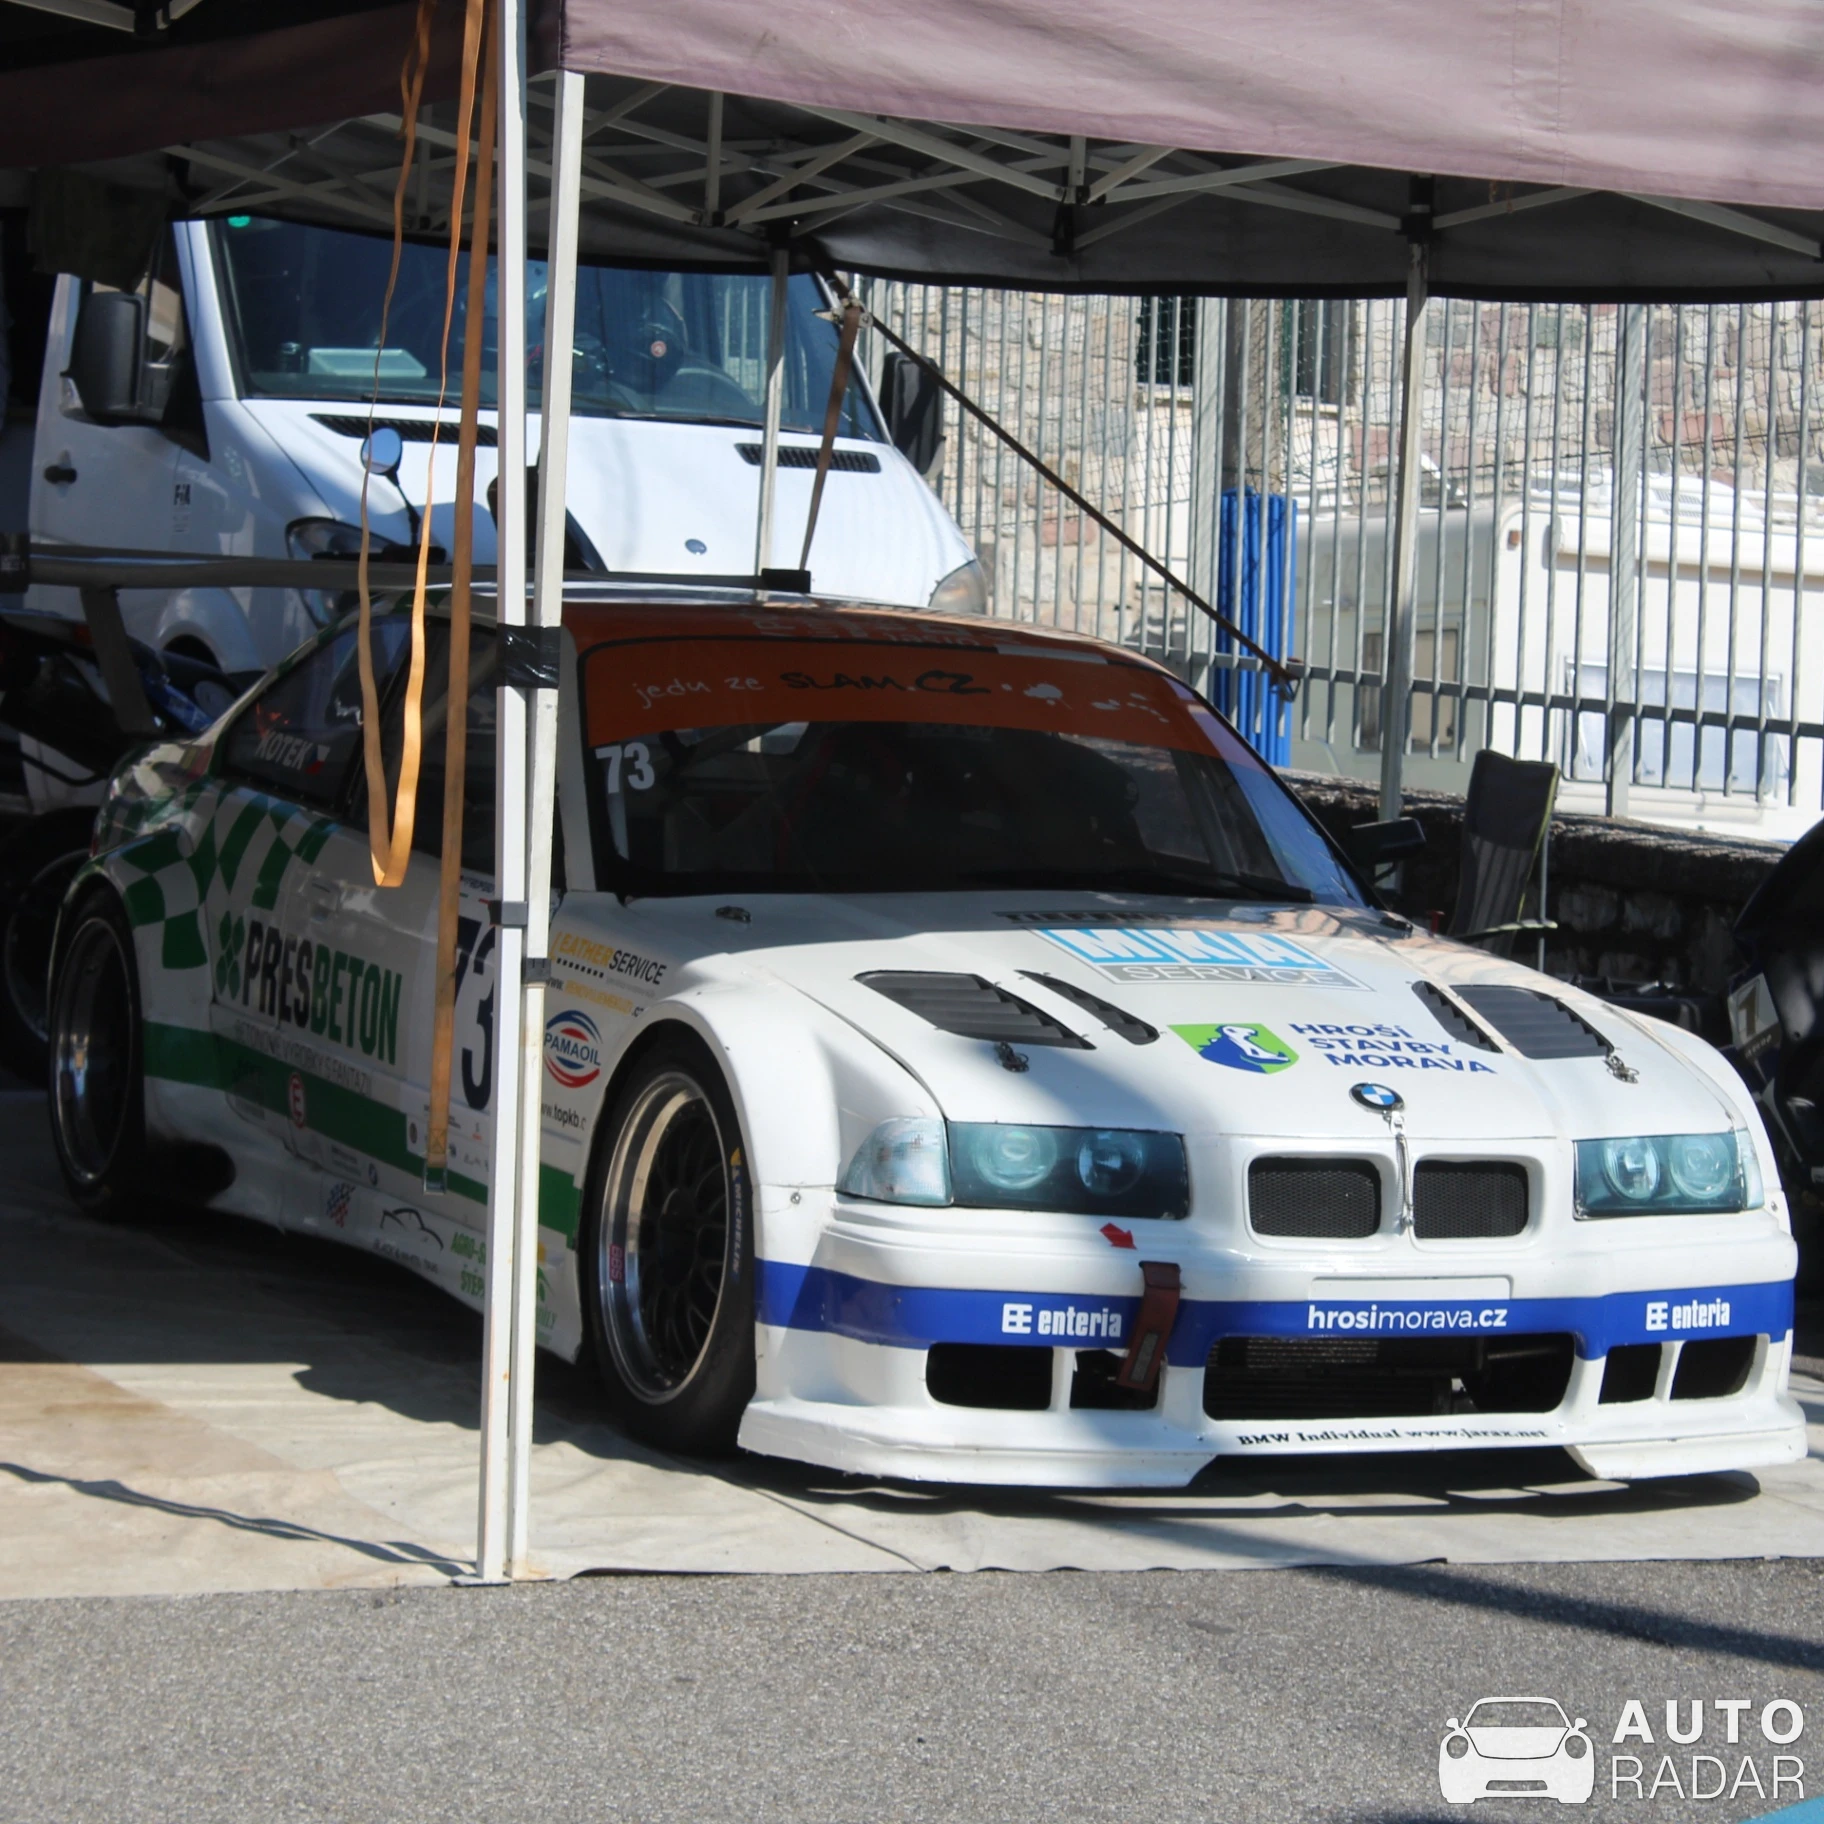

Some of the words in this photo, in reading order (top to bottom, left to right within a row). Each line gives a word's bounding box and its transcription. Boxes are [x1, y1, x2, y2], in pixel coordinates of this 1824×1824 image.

[631, 676, 711, 710] jedu
[724, 676, 765, 692] ze
[254, 728, 313, 771] KOTEK
[595, 742, 655, 793] 73
[1049, 928, 1319, 966] MKA
[1122, 966, 1346, 986] SERVICE
[242, 920, 403, 1066] PRESBETON
[543, 1031, 602, 1067] PAMAOIL
[1308, 1037, 1453, 1056] STAVBY
[1323, 1053, 1498, 1075] MORAVA
[733, 1182, 744, 1275] MICHELIN
[1037, 1306, 1122, 1338] enteria
[1307, 1304, 1508, 1330] hrosimorava.cz
[1671, 1297, 1731, 1330] enteria
[1236, 1432, 1291, 1446] BMW
[1296, 1428, 1402, 1443] Individual
[1405, 1427, 1549, 1440] www.jarax.net
